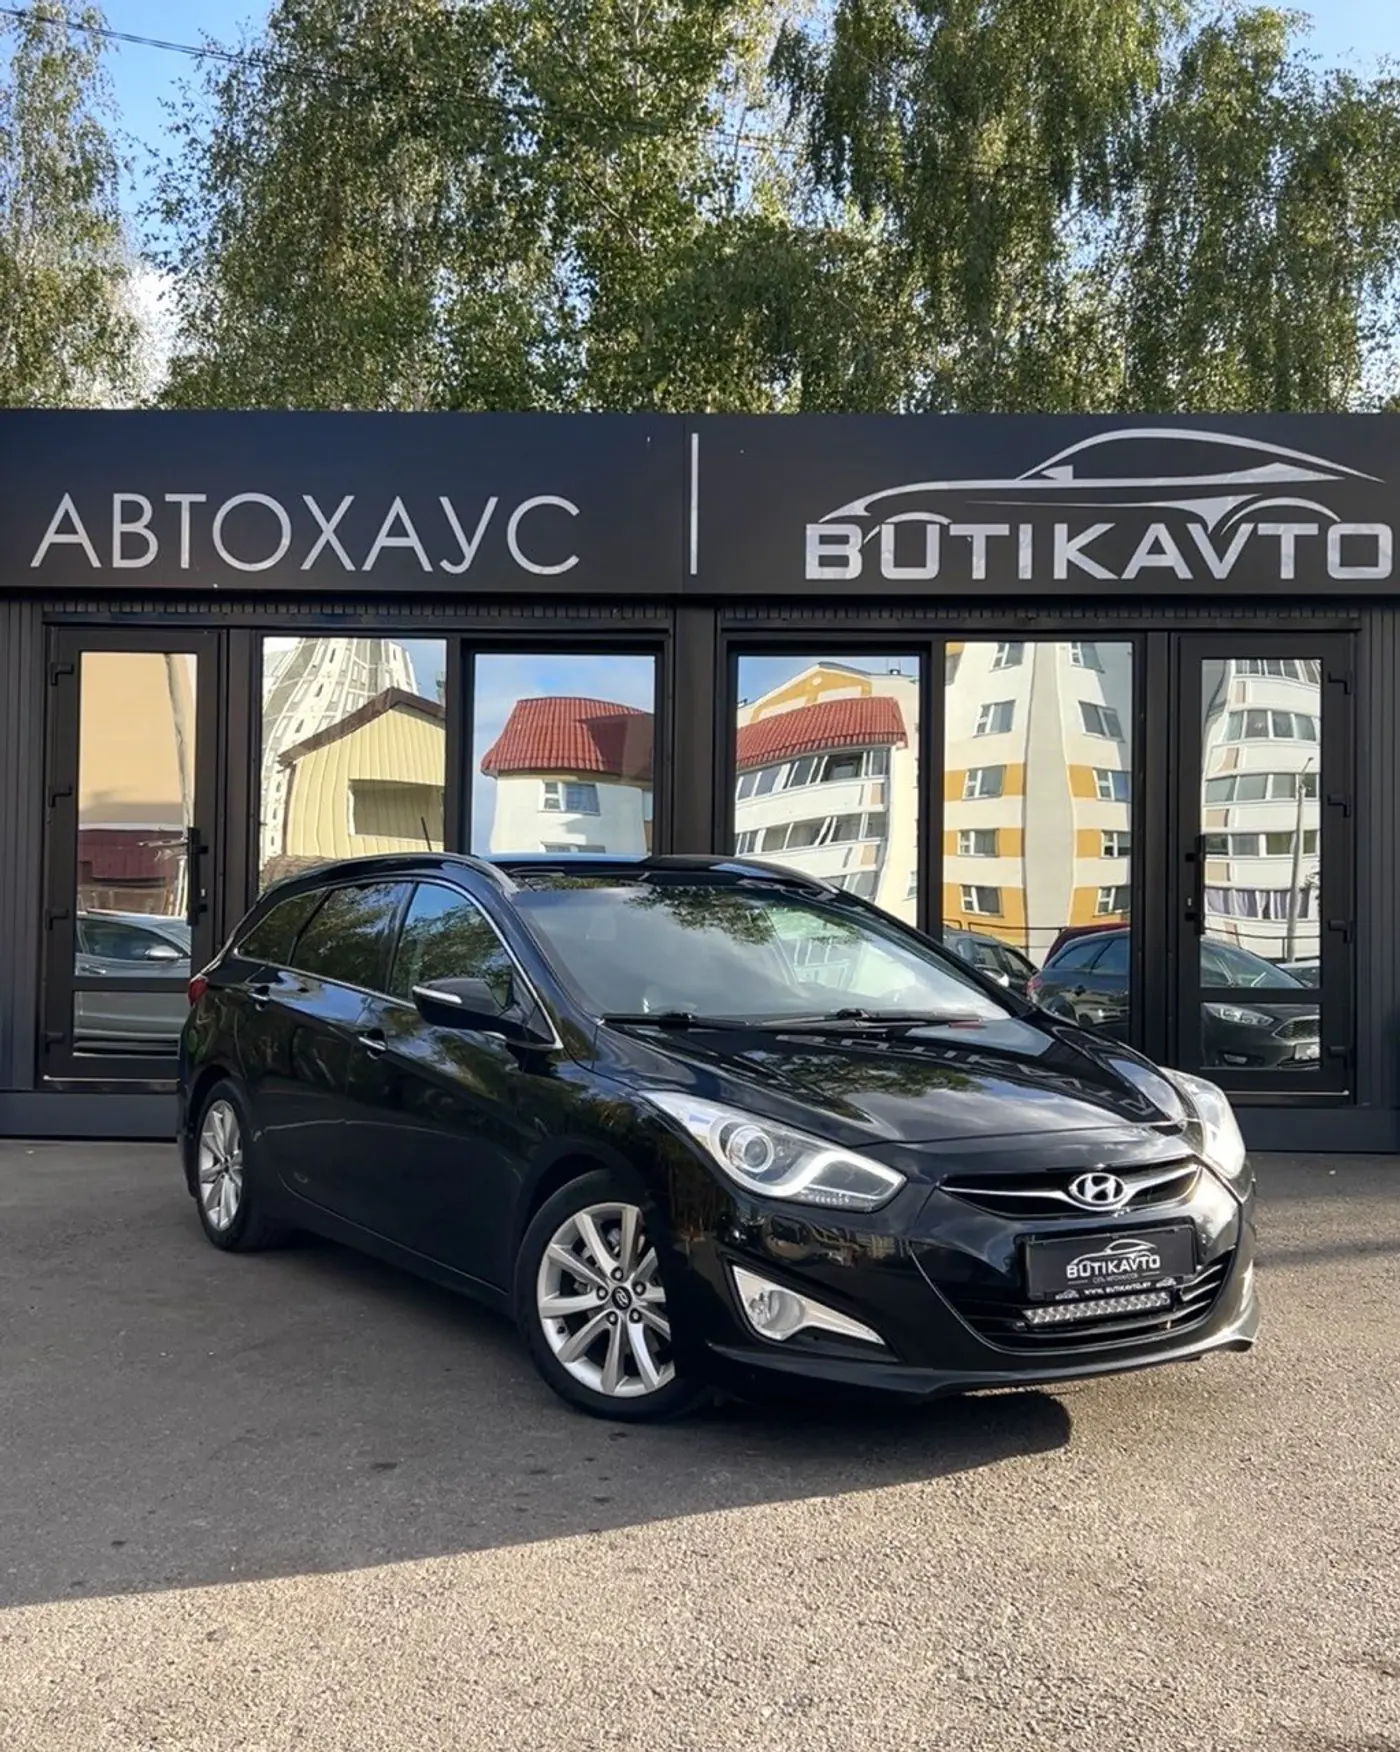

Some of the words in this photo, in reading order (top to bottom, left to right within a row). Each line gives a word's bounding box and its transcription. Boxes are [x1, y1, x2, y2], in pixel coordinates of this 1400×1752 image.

[30, 492, 580, 575] АВТОХАУС
[804, 523, 1393, 580] BUTIKAVTO
[1066, 1256, 1160, 1278] BUTIKAVTO
